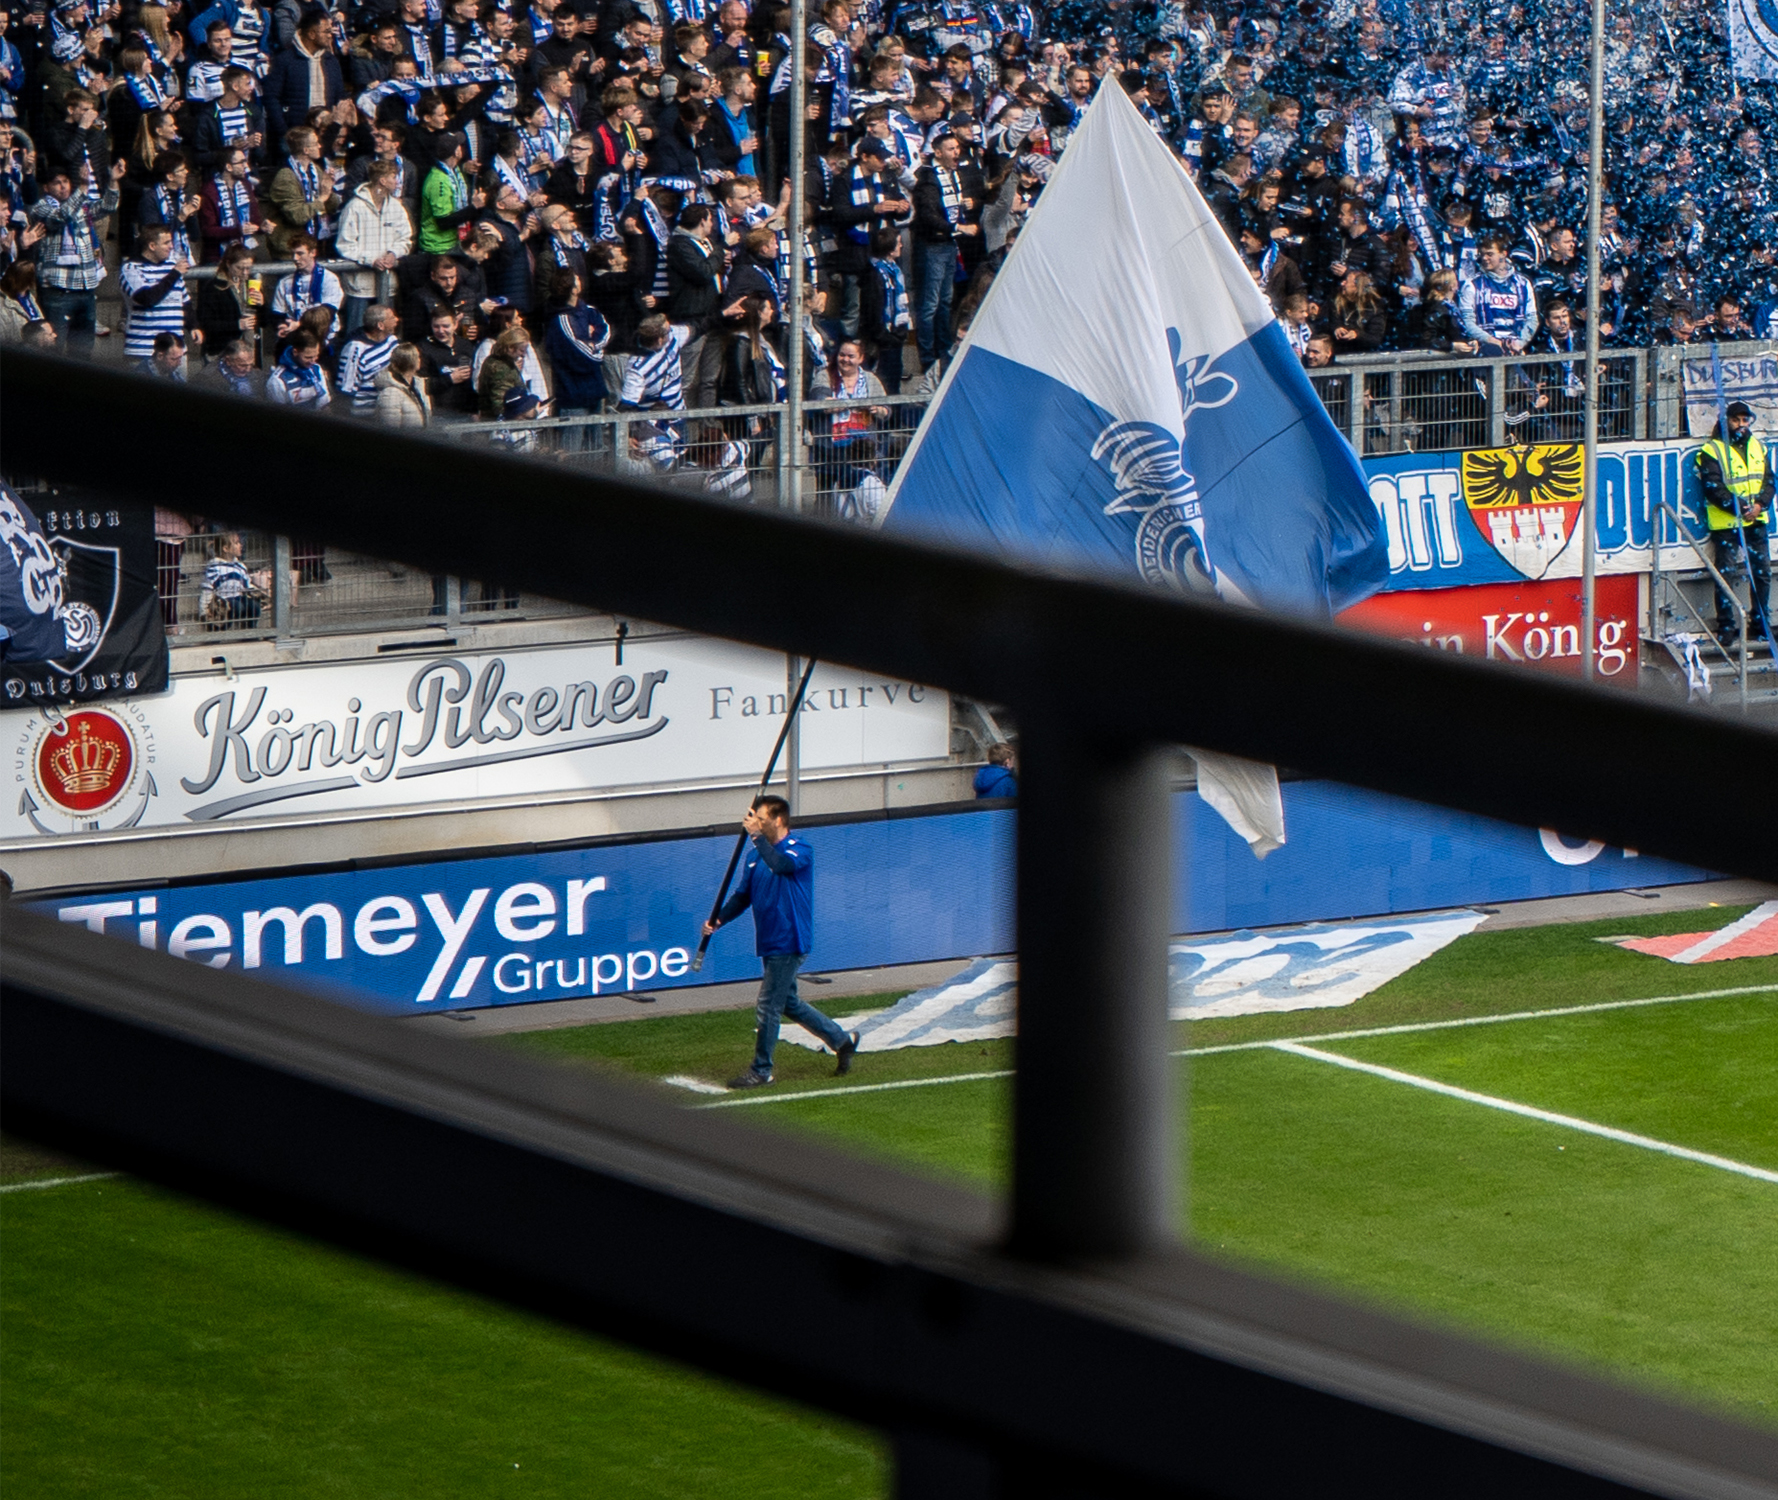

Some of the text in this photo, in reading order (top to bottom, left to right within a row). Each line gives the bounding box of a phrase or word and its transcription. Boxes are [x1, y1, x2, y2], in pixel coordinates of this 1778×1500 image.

[1488, 293, 1518, 309] OXS
[1686, 358, 1778, 388] DUSBUR
[1368, 468, 1464, 575] OTT
[1596, 449, 1722, 554] DUIS
[1483, 611, 1628, 676] Köng
[6, 671, 139, 700] Duisburg
[709, 674, 925, 720] Fankurve
[121, 699, 156, 765] AUDATUR
[181, 657, 669, 795] König Pilsener
[57, 875, 606, 1003] Tiemeyer
[493, 947, 690, 996] Gruppe
